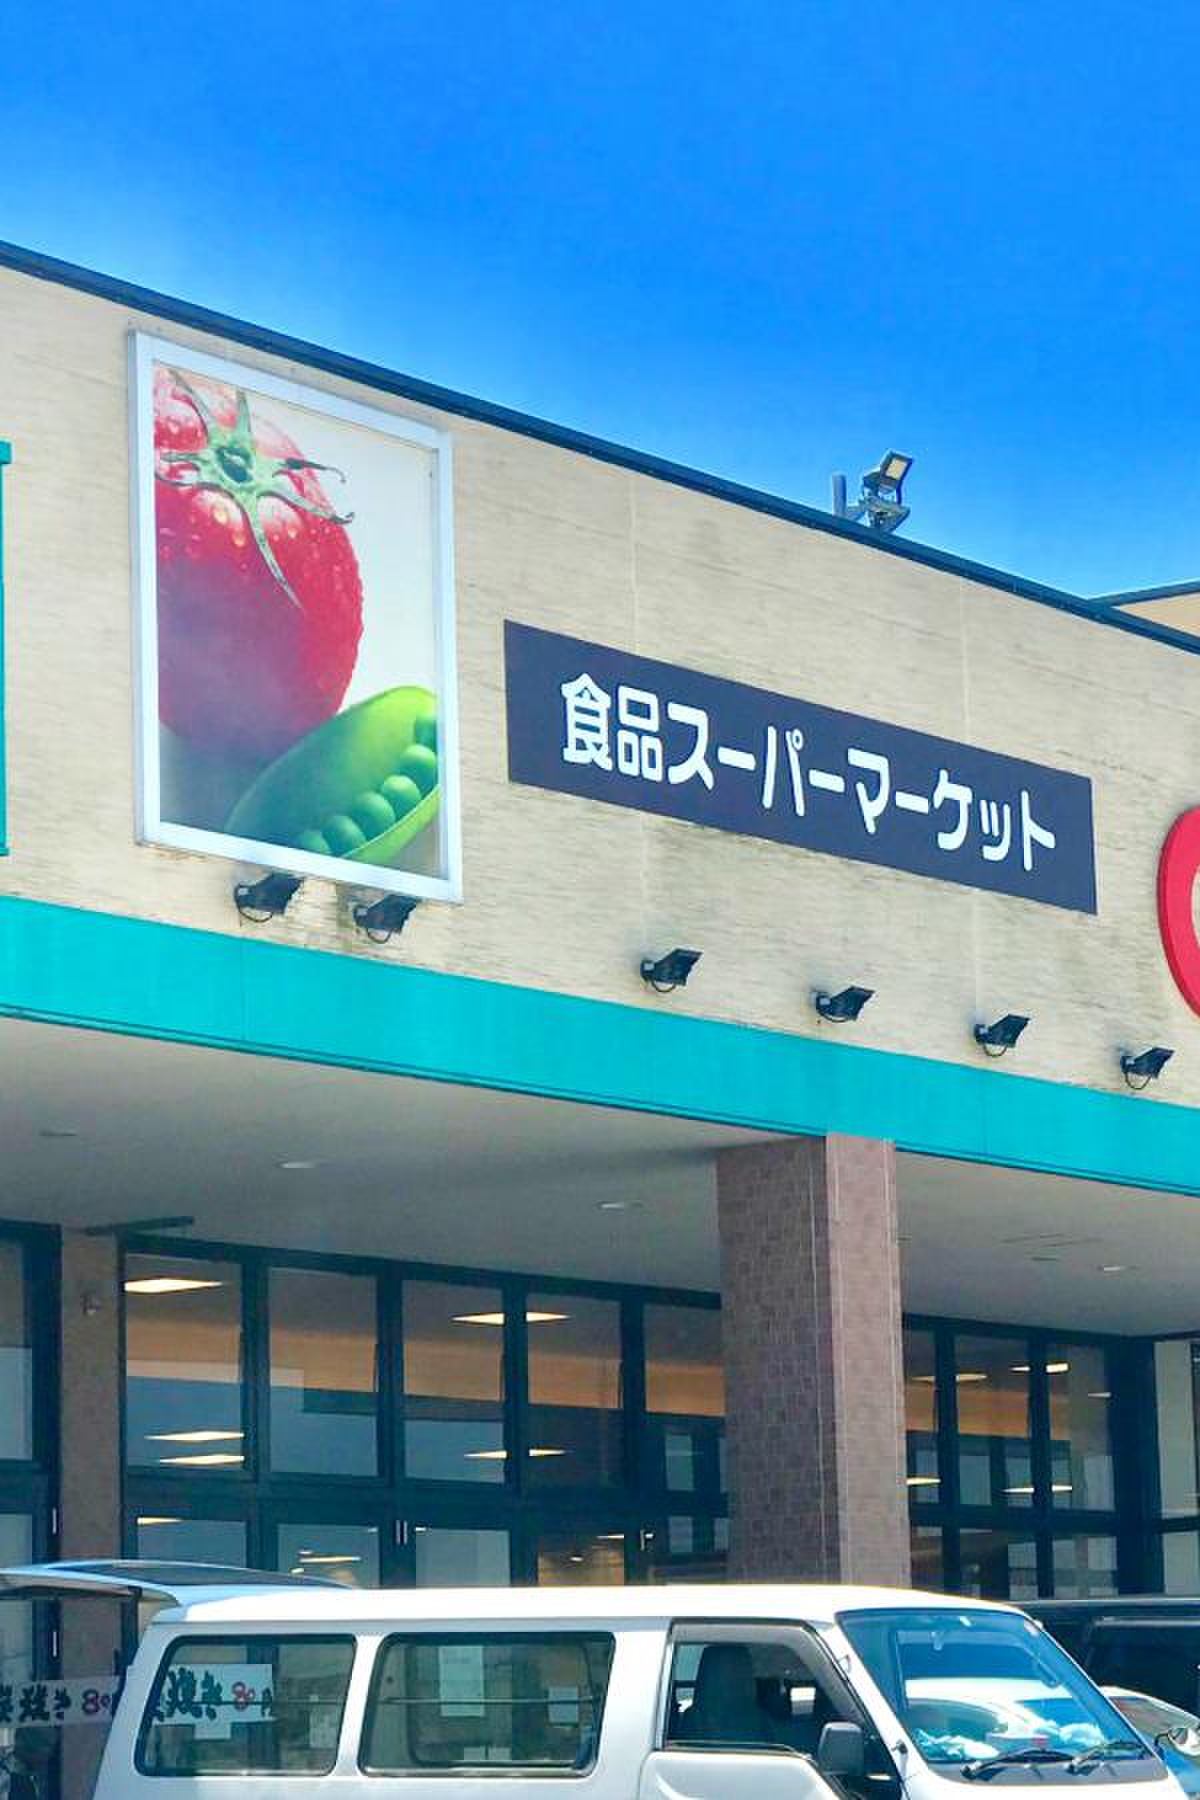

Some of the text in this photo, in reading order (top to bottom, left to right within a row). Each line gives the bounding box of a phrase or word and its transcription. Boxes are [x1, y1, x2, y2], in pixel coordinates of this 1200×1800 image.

[561, 673, 1055, 871] 食品スーパーマーケット
